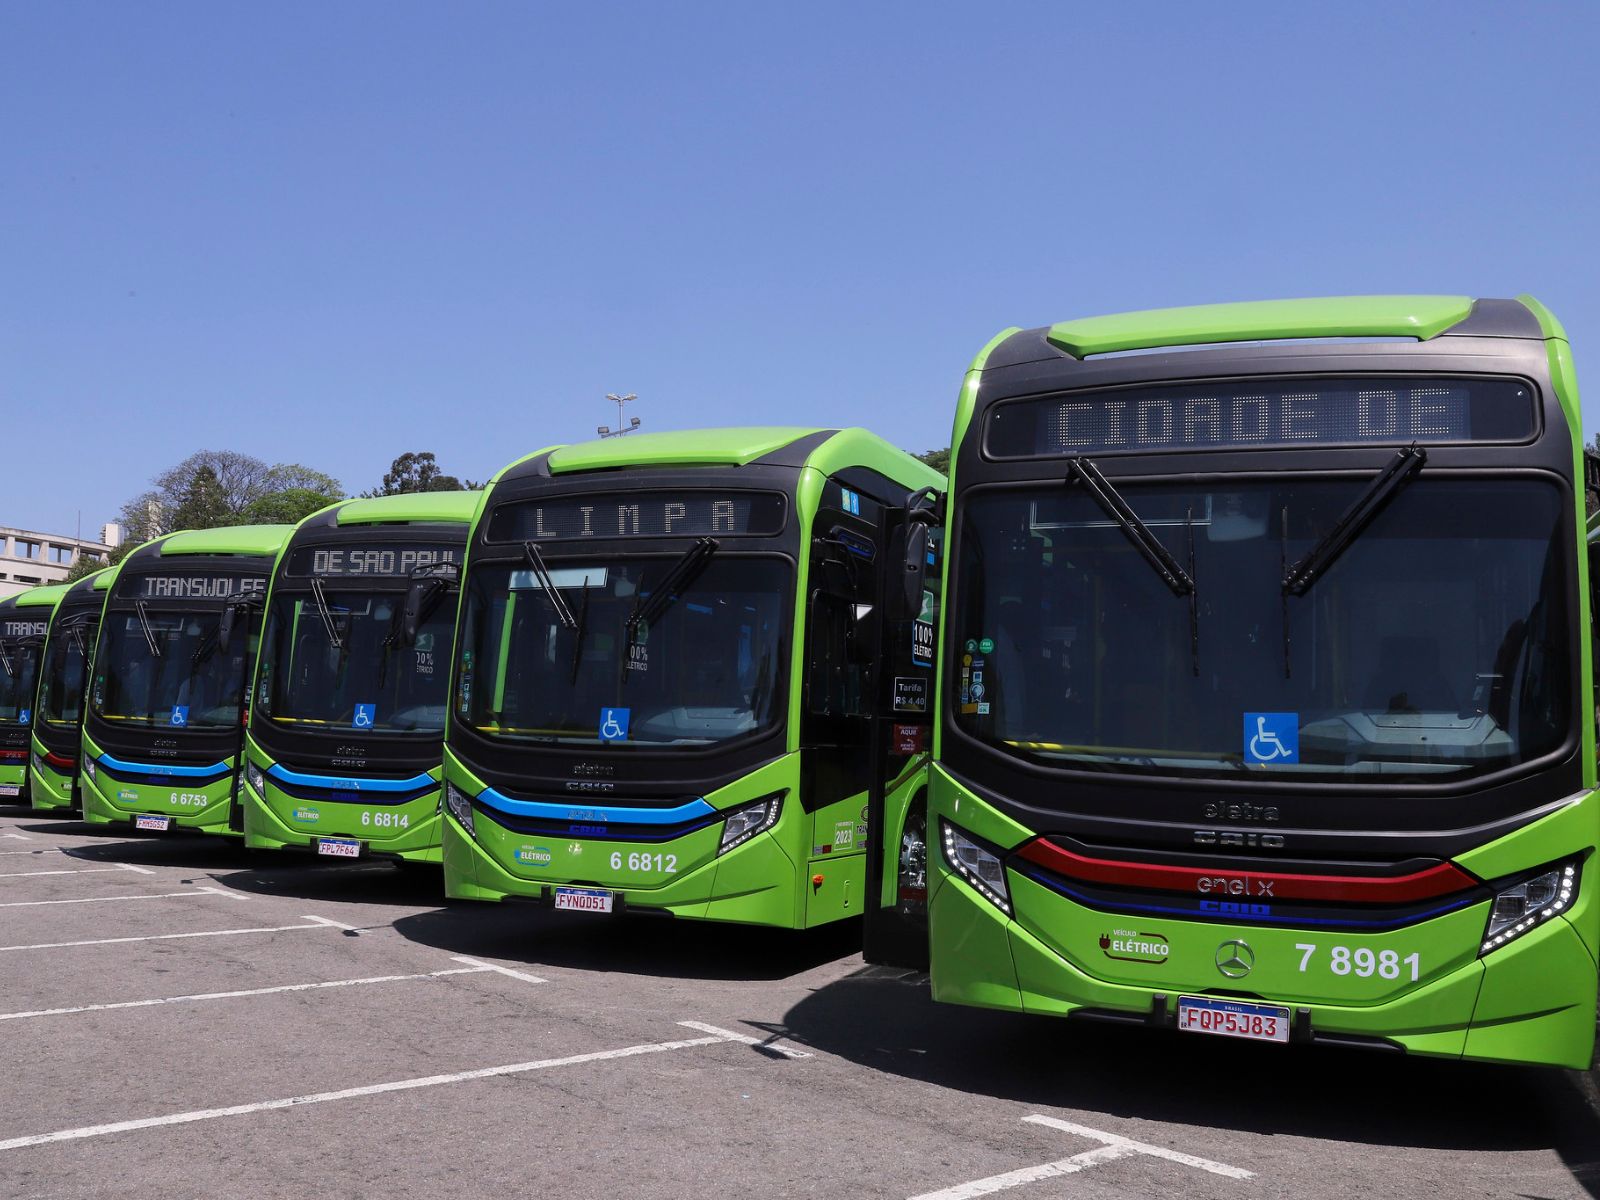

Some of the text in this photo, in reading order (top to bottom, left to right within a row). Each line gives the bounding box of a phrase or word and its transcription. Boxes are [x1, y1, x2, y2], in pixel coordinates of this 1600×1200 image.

[1059, 388, 1450, 446] CIDADE DE
[313, 550, 344, 573] DE
[5, 622, 48, 636] TRANS
[898, 683, 922, 692] Tarifa
[895, 696, 906, 705] R$
[170, 793, 208, 807] 6 6753
[1203, 800, 1280, 821] eletra
[361, 811, 409, 829] 6 6814
[836, 829, 852, 845] 2023
[1194, 830, 1285, 848] CAIO
[520, 850, 551, 861] ELÉTRICO
[610, 851, 677, 873] 6 6812
[1197, 875, 1274, 897] enel x
[1200, 900, 1272, 915] CAIO
[1112, 928, 1138, 937] VEÍCULO
[1112, 938, 1169, 956] ELÉTRICO
[1295, 943, 1420, 982] 7 8981
[1187, 1008, 1277, 1037] FQP5J83
